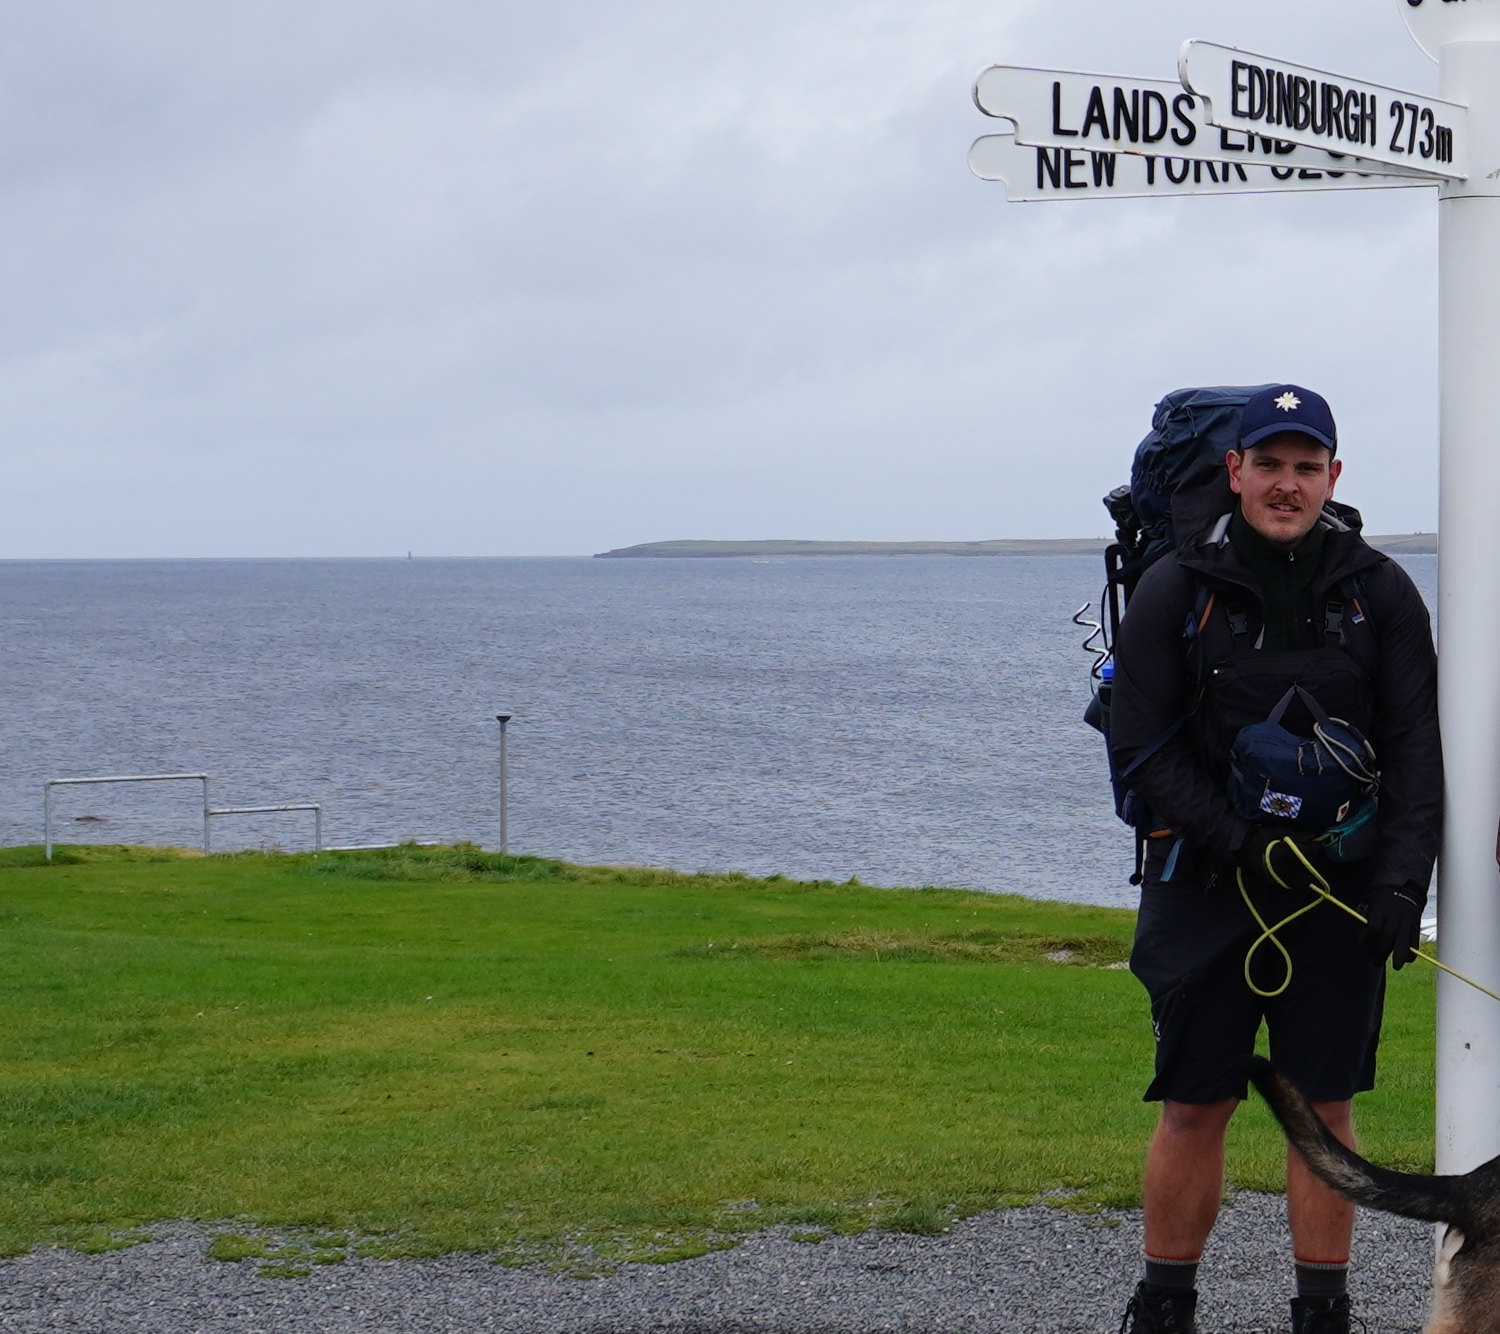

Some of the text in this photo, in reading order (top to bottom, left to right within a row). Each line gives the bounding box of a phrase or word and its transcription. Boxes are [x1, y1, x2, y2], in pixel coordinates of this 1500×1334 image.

[1052, 81, 1197, 146] LANDS
[1232, 59, 1453, 164] EDINBURGH 273m
[1036, 147, 1116, 189] NEW
